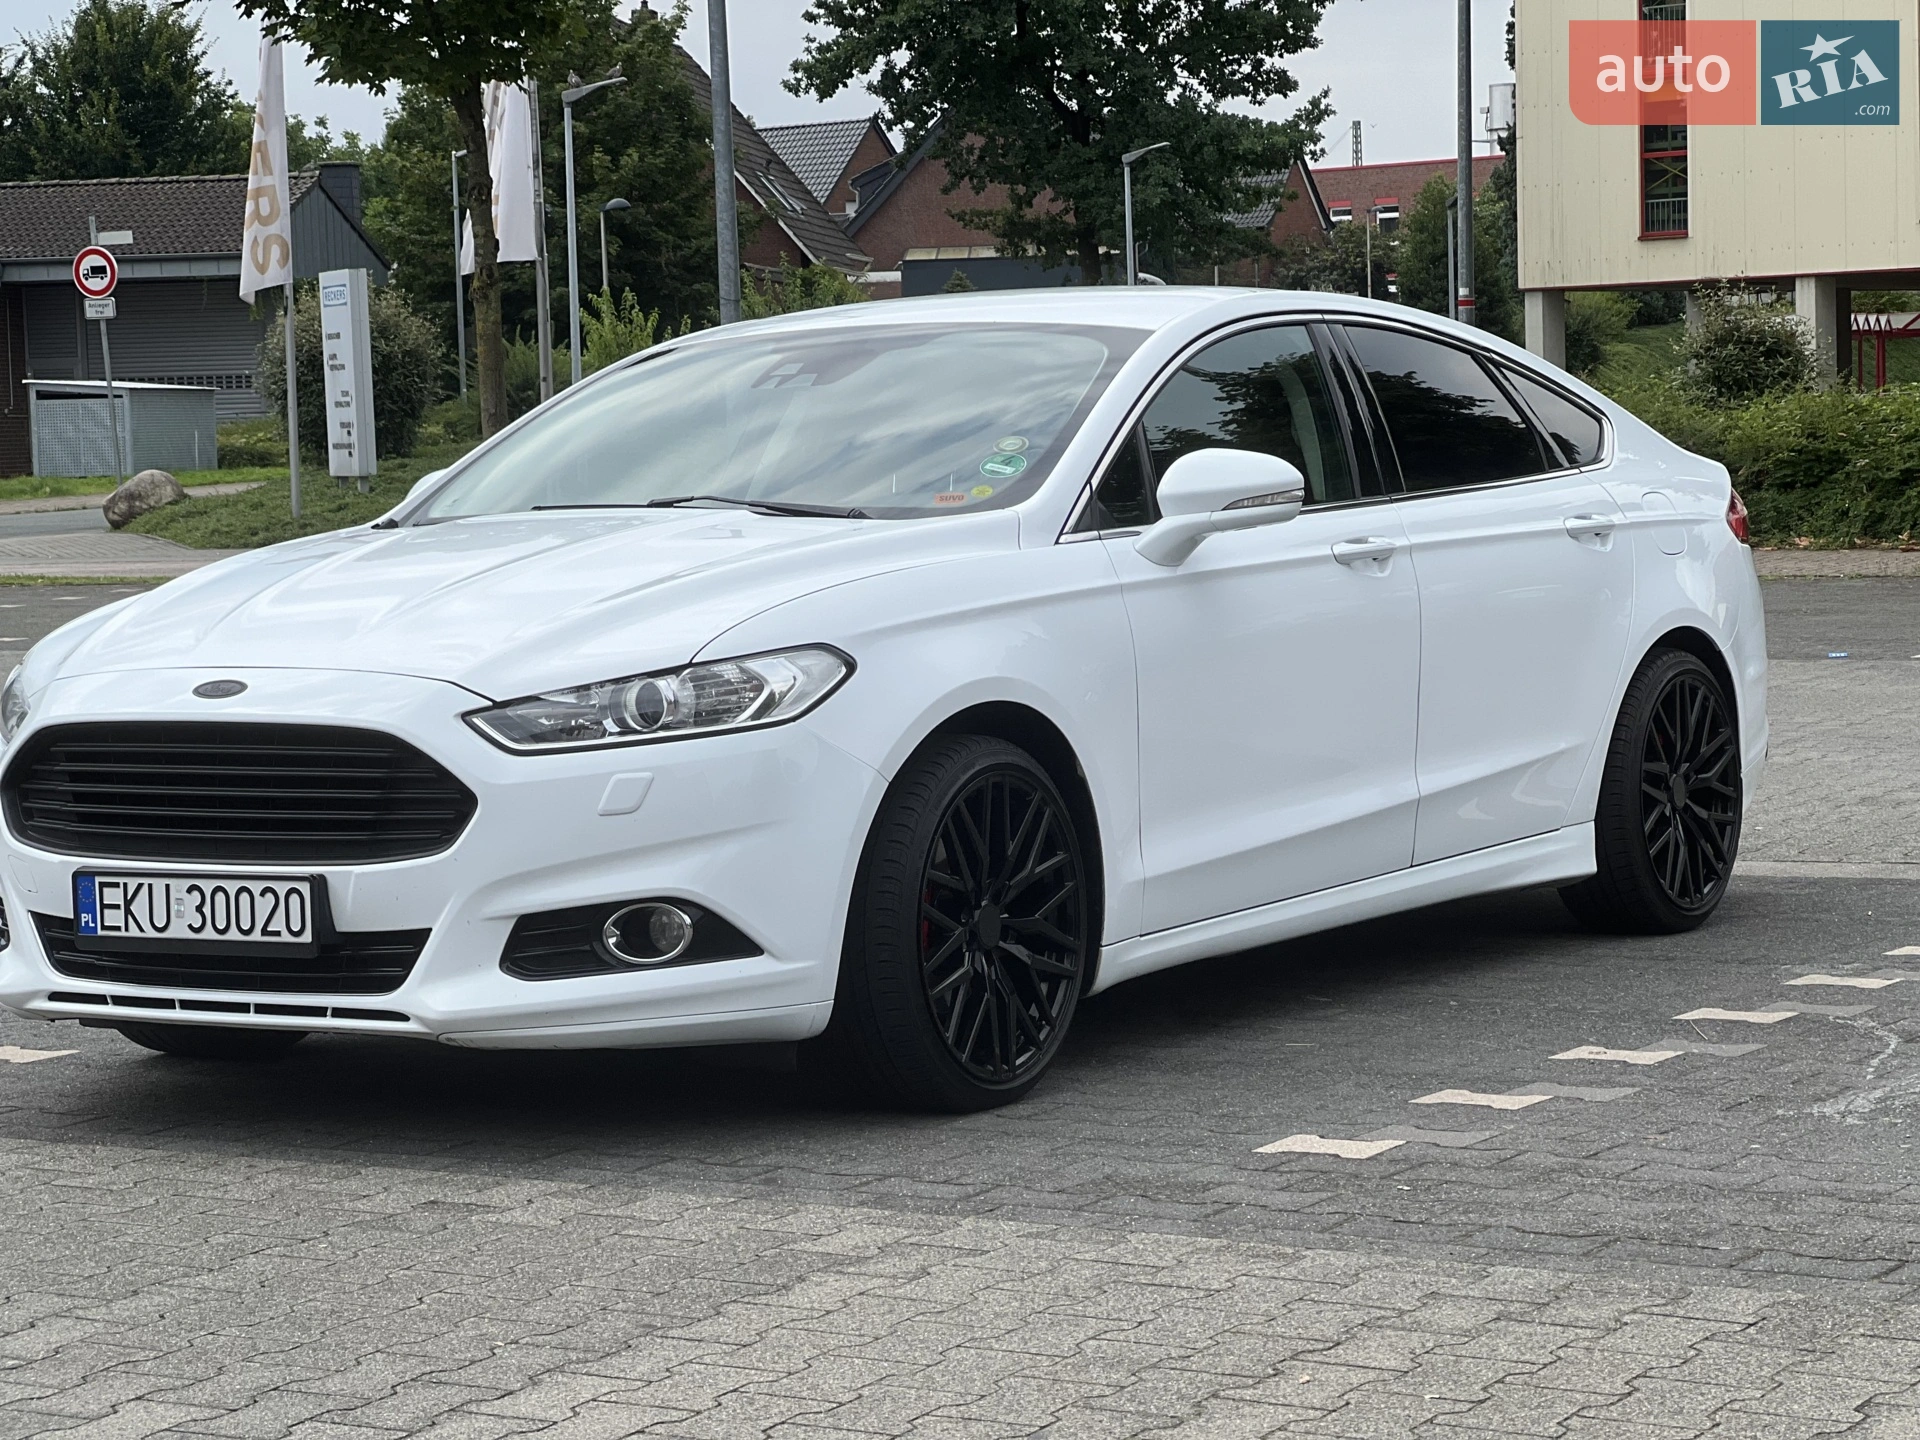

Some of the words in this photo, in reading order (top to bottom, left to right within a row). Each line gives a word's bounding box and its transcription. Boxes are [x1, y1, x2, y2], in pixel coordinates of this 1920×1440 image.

[324, 289, 346, 302] RECKERS
[98, 881, 171, 933] EKU
[185, 883, 306, 938] 30020
[81, 913, 95, 927] PL
